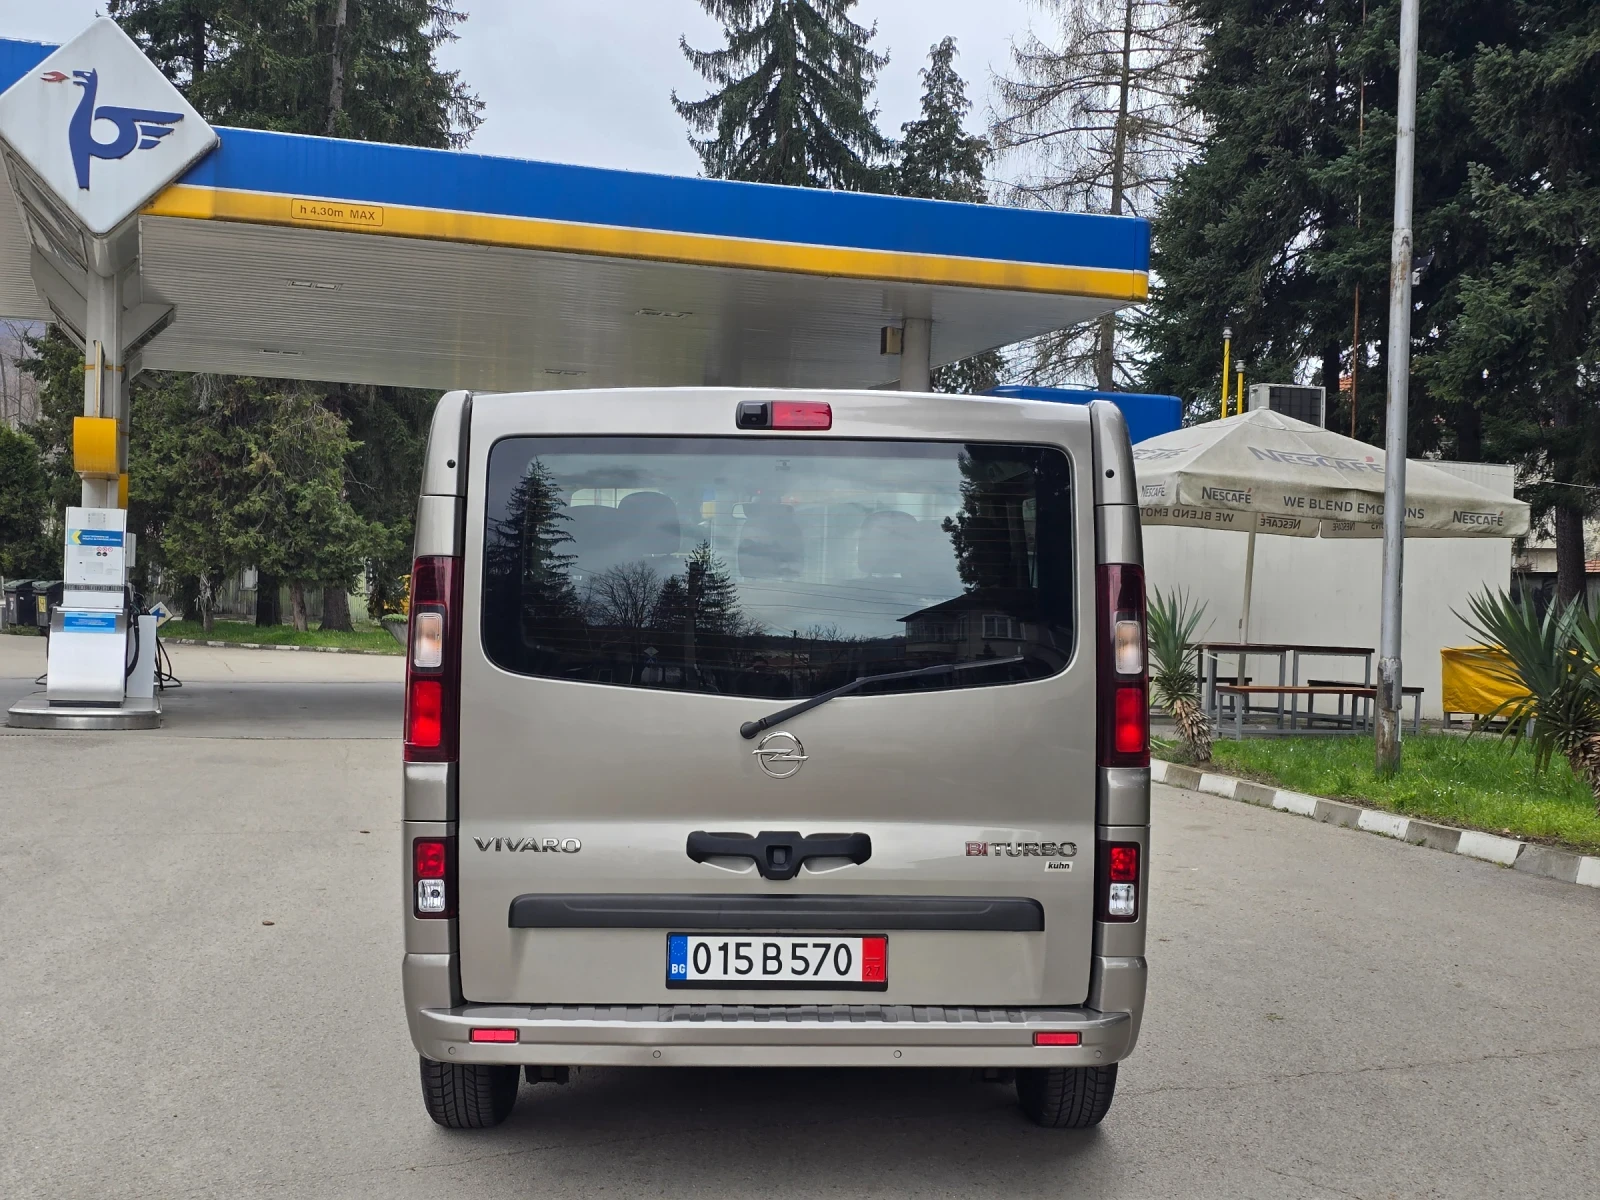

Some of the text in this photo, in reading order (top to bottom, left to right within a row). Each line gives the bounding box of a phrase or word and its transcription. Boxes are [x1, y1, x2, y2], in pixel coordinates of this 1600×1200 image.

[300, 205, 376, 220] h 4.30m MAX
[1247, 446, 1386, 473] NESCAFÉ
[1201, 487, 1504, 526] NESCAFÉ WE BLEND EMONS NESCAFÉ
[473, 836, 582, 853] VIVARO
[1047, 861, 1070, 870] kuhn
[671, 963, 686, 974] BG
